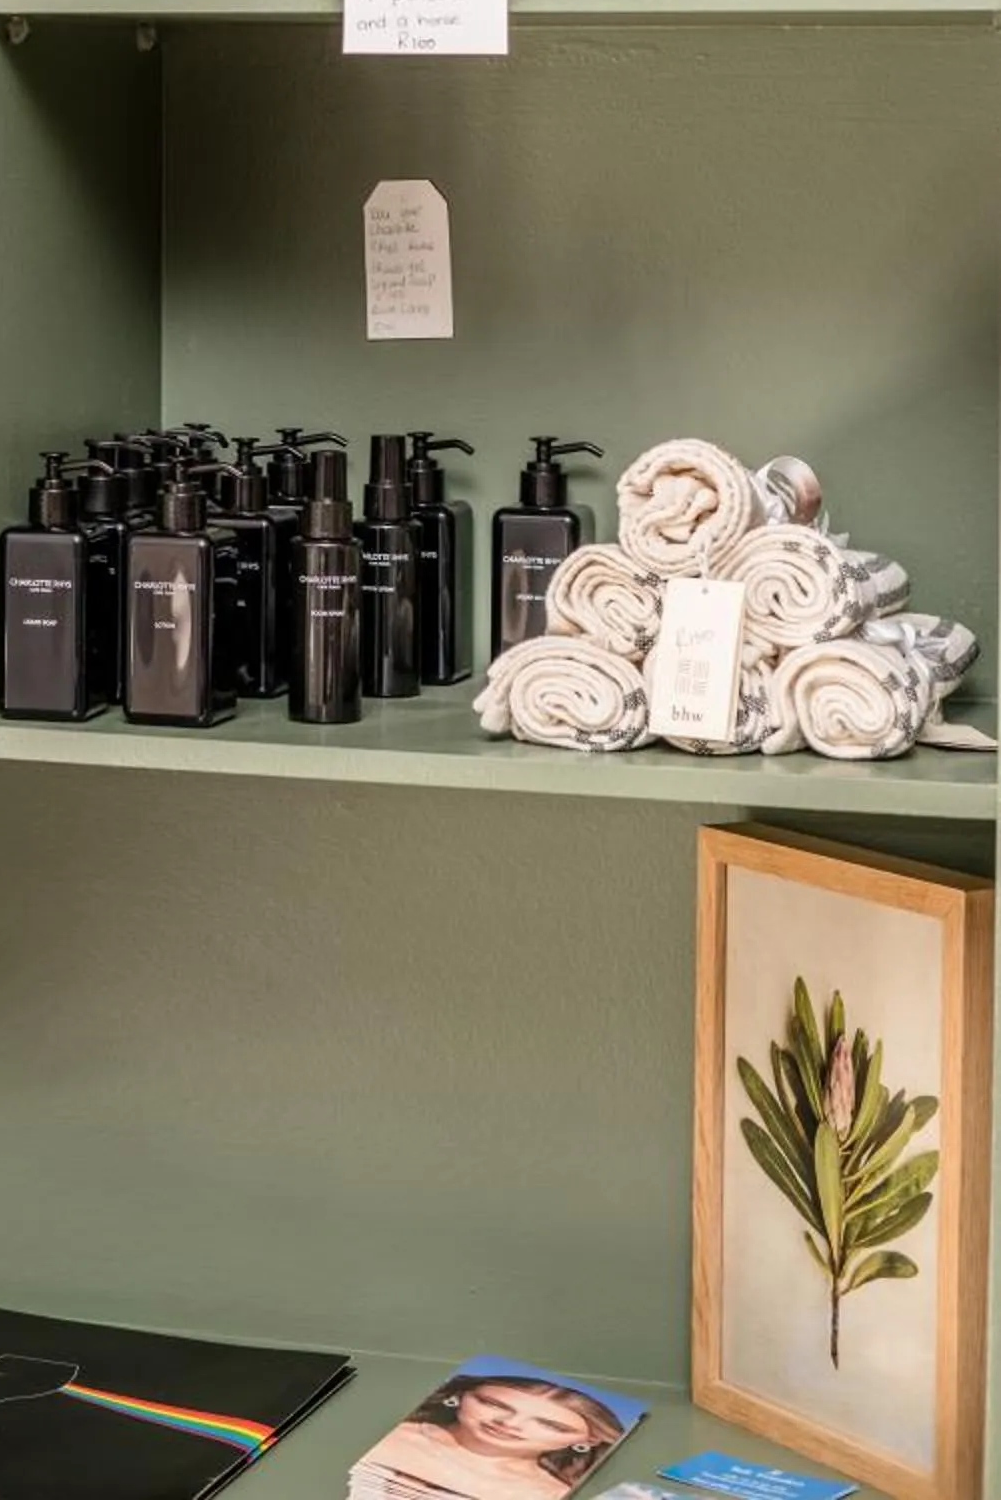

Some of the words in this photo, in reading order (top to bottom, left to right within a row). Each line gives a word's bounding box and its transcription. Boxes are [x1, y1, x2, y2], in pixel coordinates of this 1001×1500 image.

[356, 14, 386, 32] and
[397, 15, 408, 28] a
[671, 703, 704, 723] bhw
